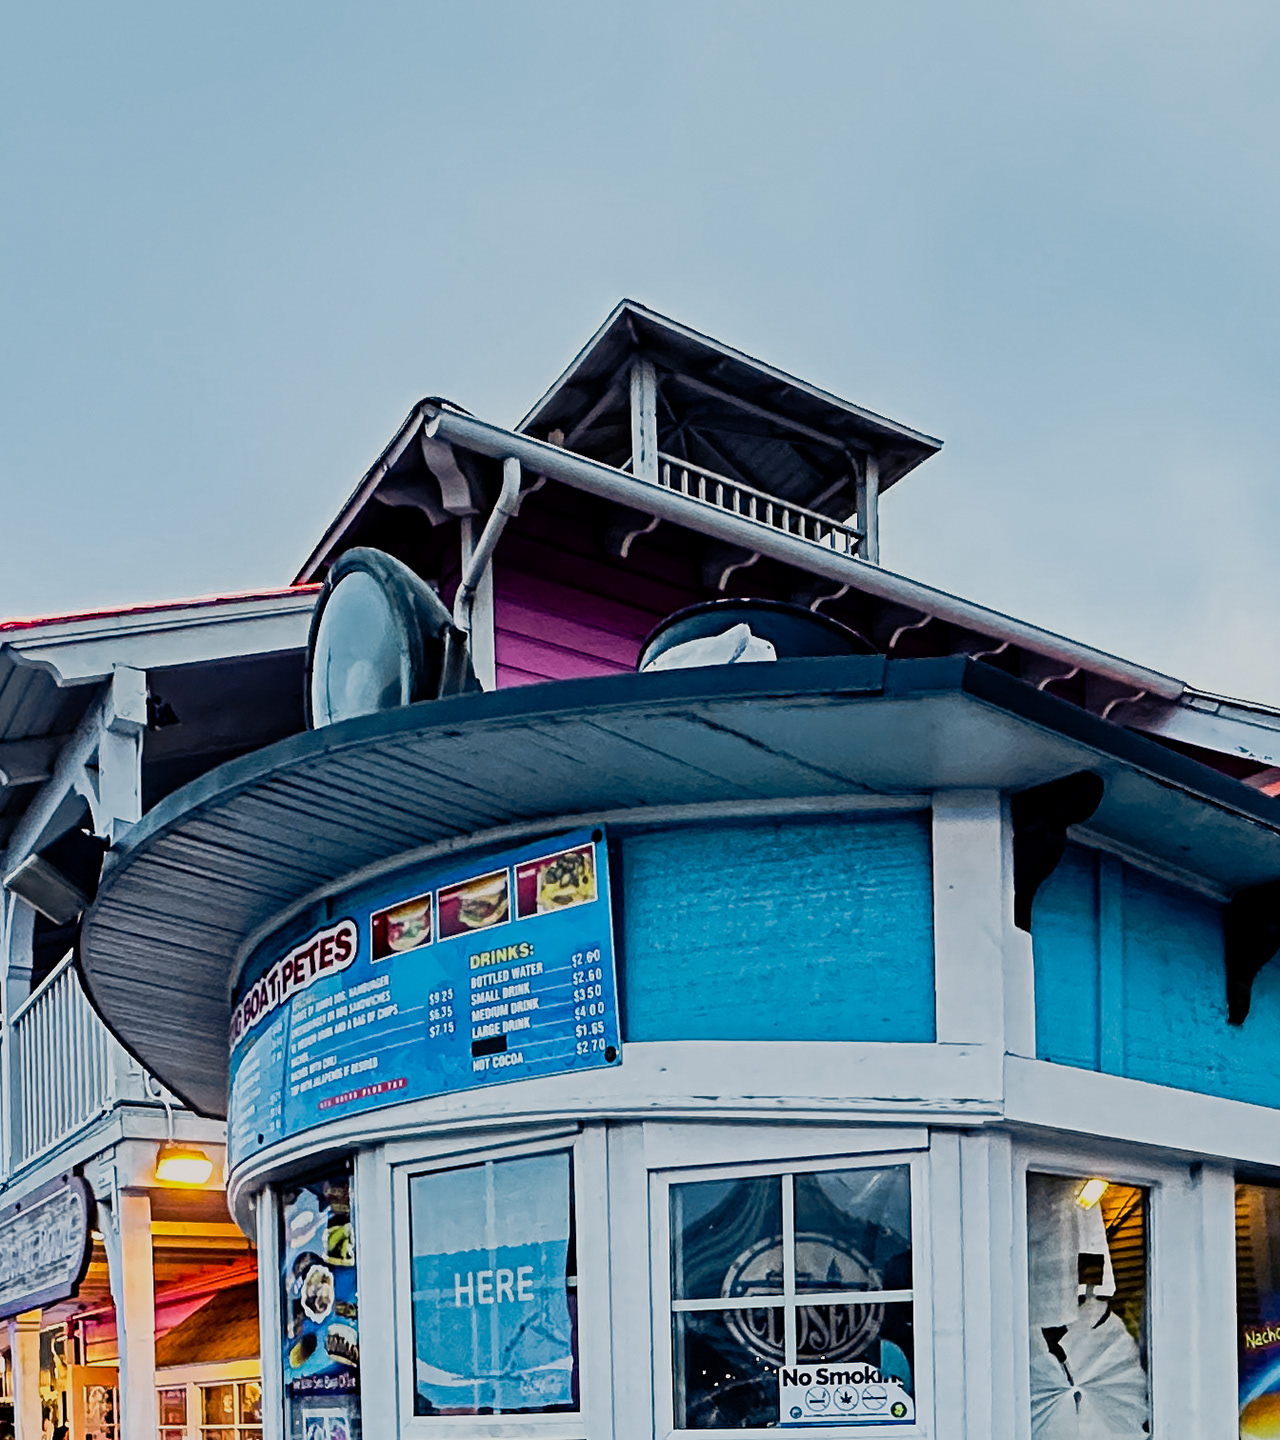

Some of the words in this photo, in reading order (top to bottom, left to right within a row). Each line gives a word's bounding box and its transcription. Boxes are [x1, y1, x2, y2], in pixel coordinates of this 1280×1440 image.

[470, 942, 534, 969] DRINKS:
[244, 970, 279, 1029] BOAT
[282, 928, 352, 995] PETES
[471, 967, 509, 989] BOTTLED
[511, 962, 544, 980] WATER
[471, 989, 501, 1007] SMALL
[502, 982, 531, 999] DRINK
[428, 1005, 453, 1022] $6.35
[471, 1004, 509, 1023] MEDIUM
[510, 998, 540, 1014] DRINK
[472, 1023, 500, 1040] LARGE
[502, 1017, 531, 1033] DRINK
[472, 1057, 491, 1072] HOT
[492, 1052, 524, 1069] COCOA
[454, 1265, 535, 1307] HERE
[782, 1368, 812, 1387] No
[816, 1366, 904, 1387] Smokin
